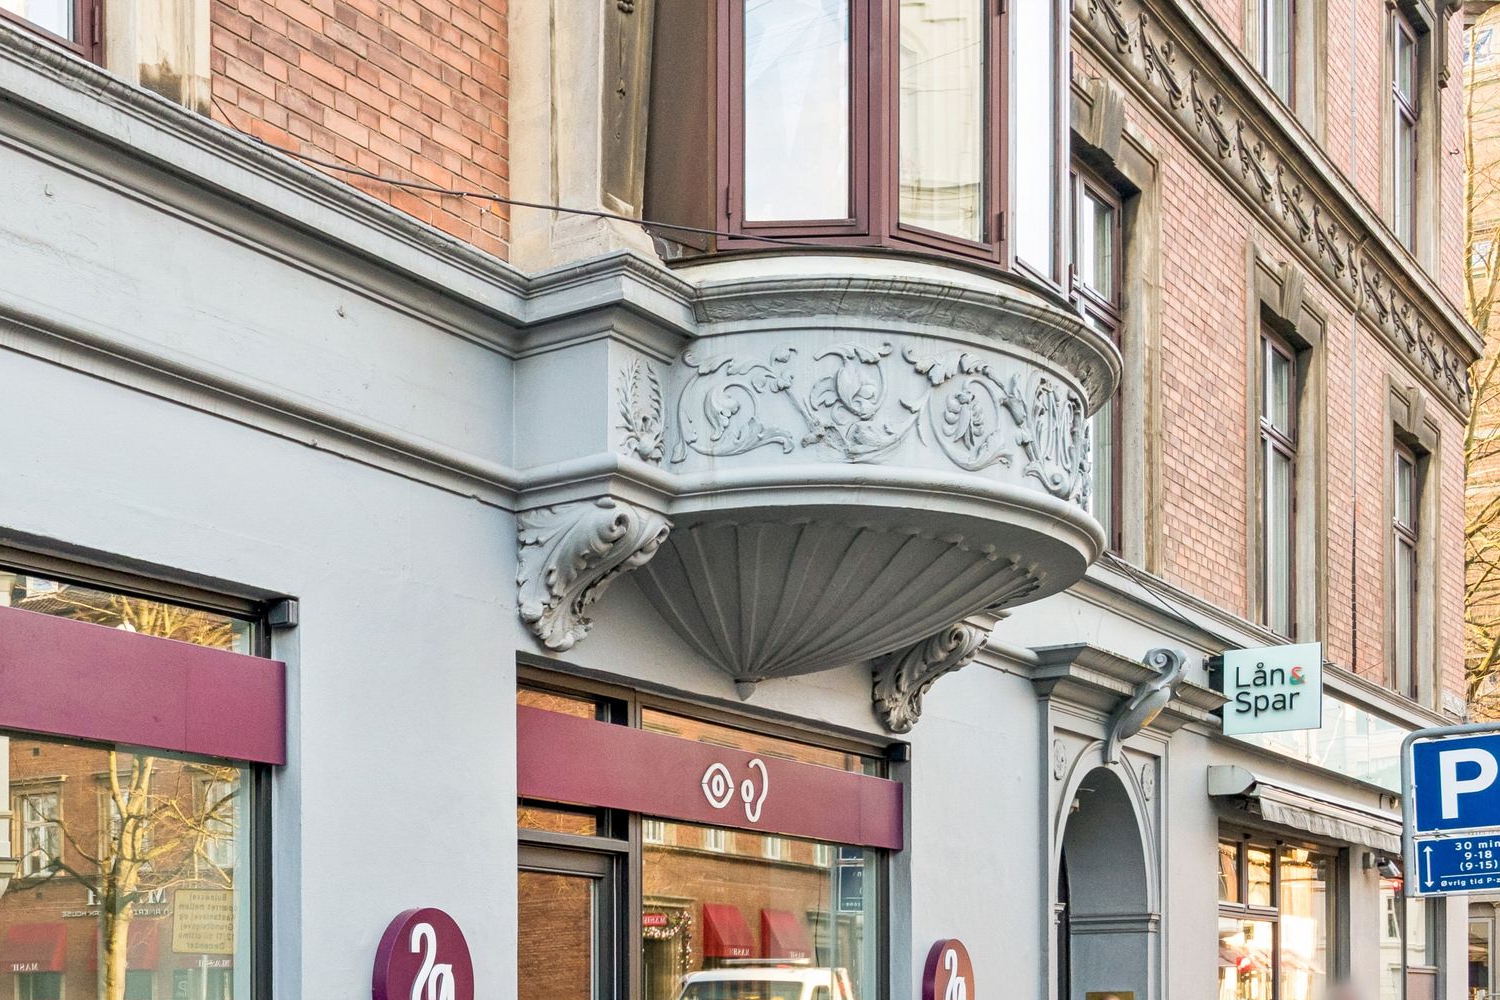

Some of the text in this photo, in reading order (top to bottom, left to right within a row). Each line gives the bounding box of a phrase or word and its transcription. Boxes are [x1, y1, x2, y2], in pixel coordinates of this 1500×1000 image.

[1235, 691, 1301, 717] Spar
[1439, 748, 1499, 820] P
[1455, 841, 1472, 851] 30
[1464, 850, 1492, 860] 9-18
[1460, 859, 1498, 872] (9-15)
[1440, 879, 1466, 887] Øvrig
[1470, 877, 1483, 885] tid
